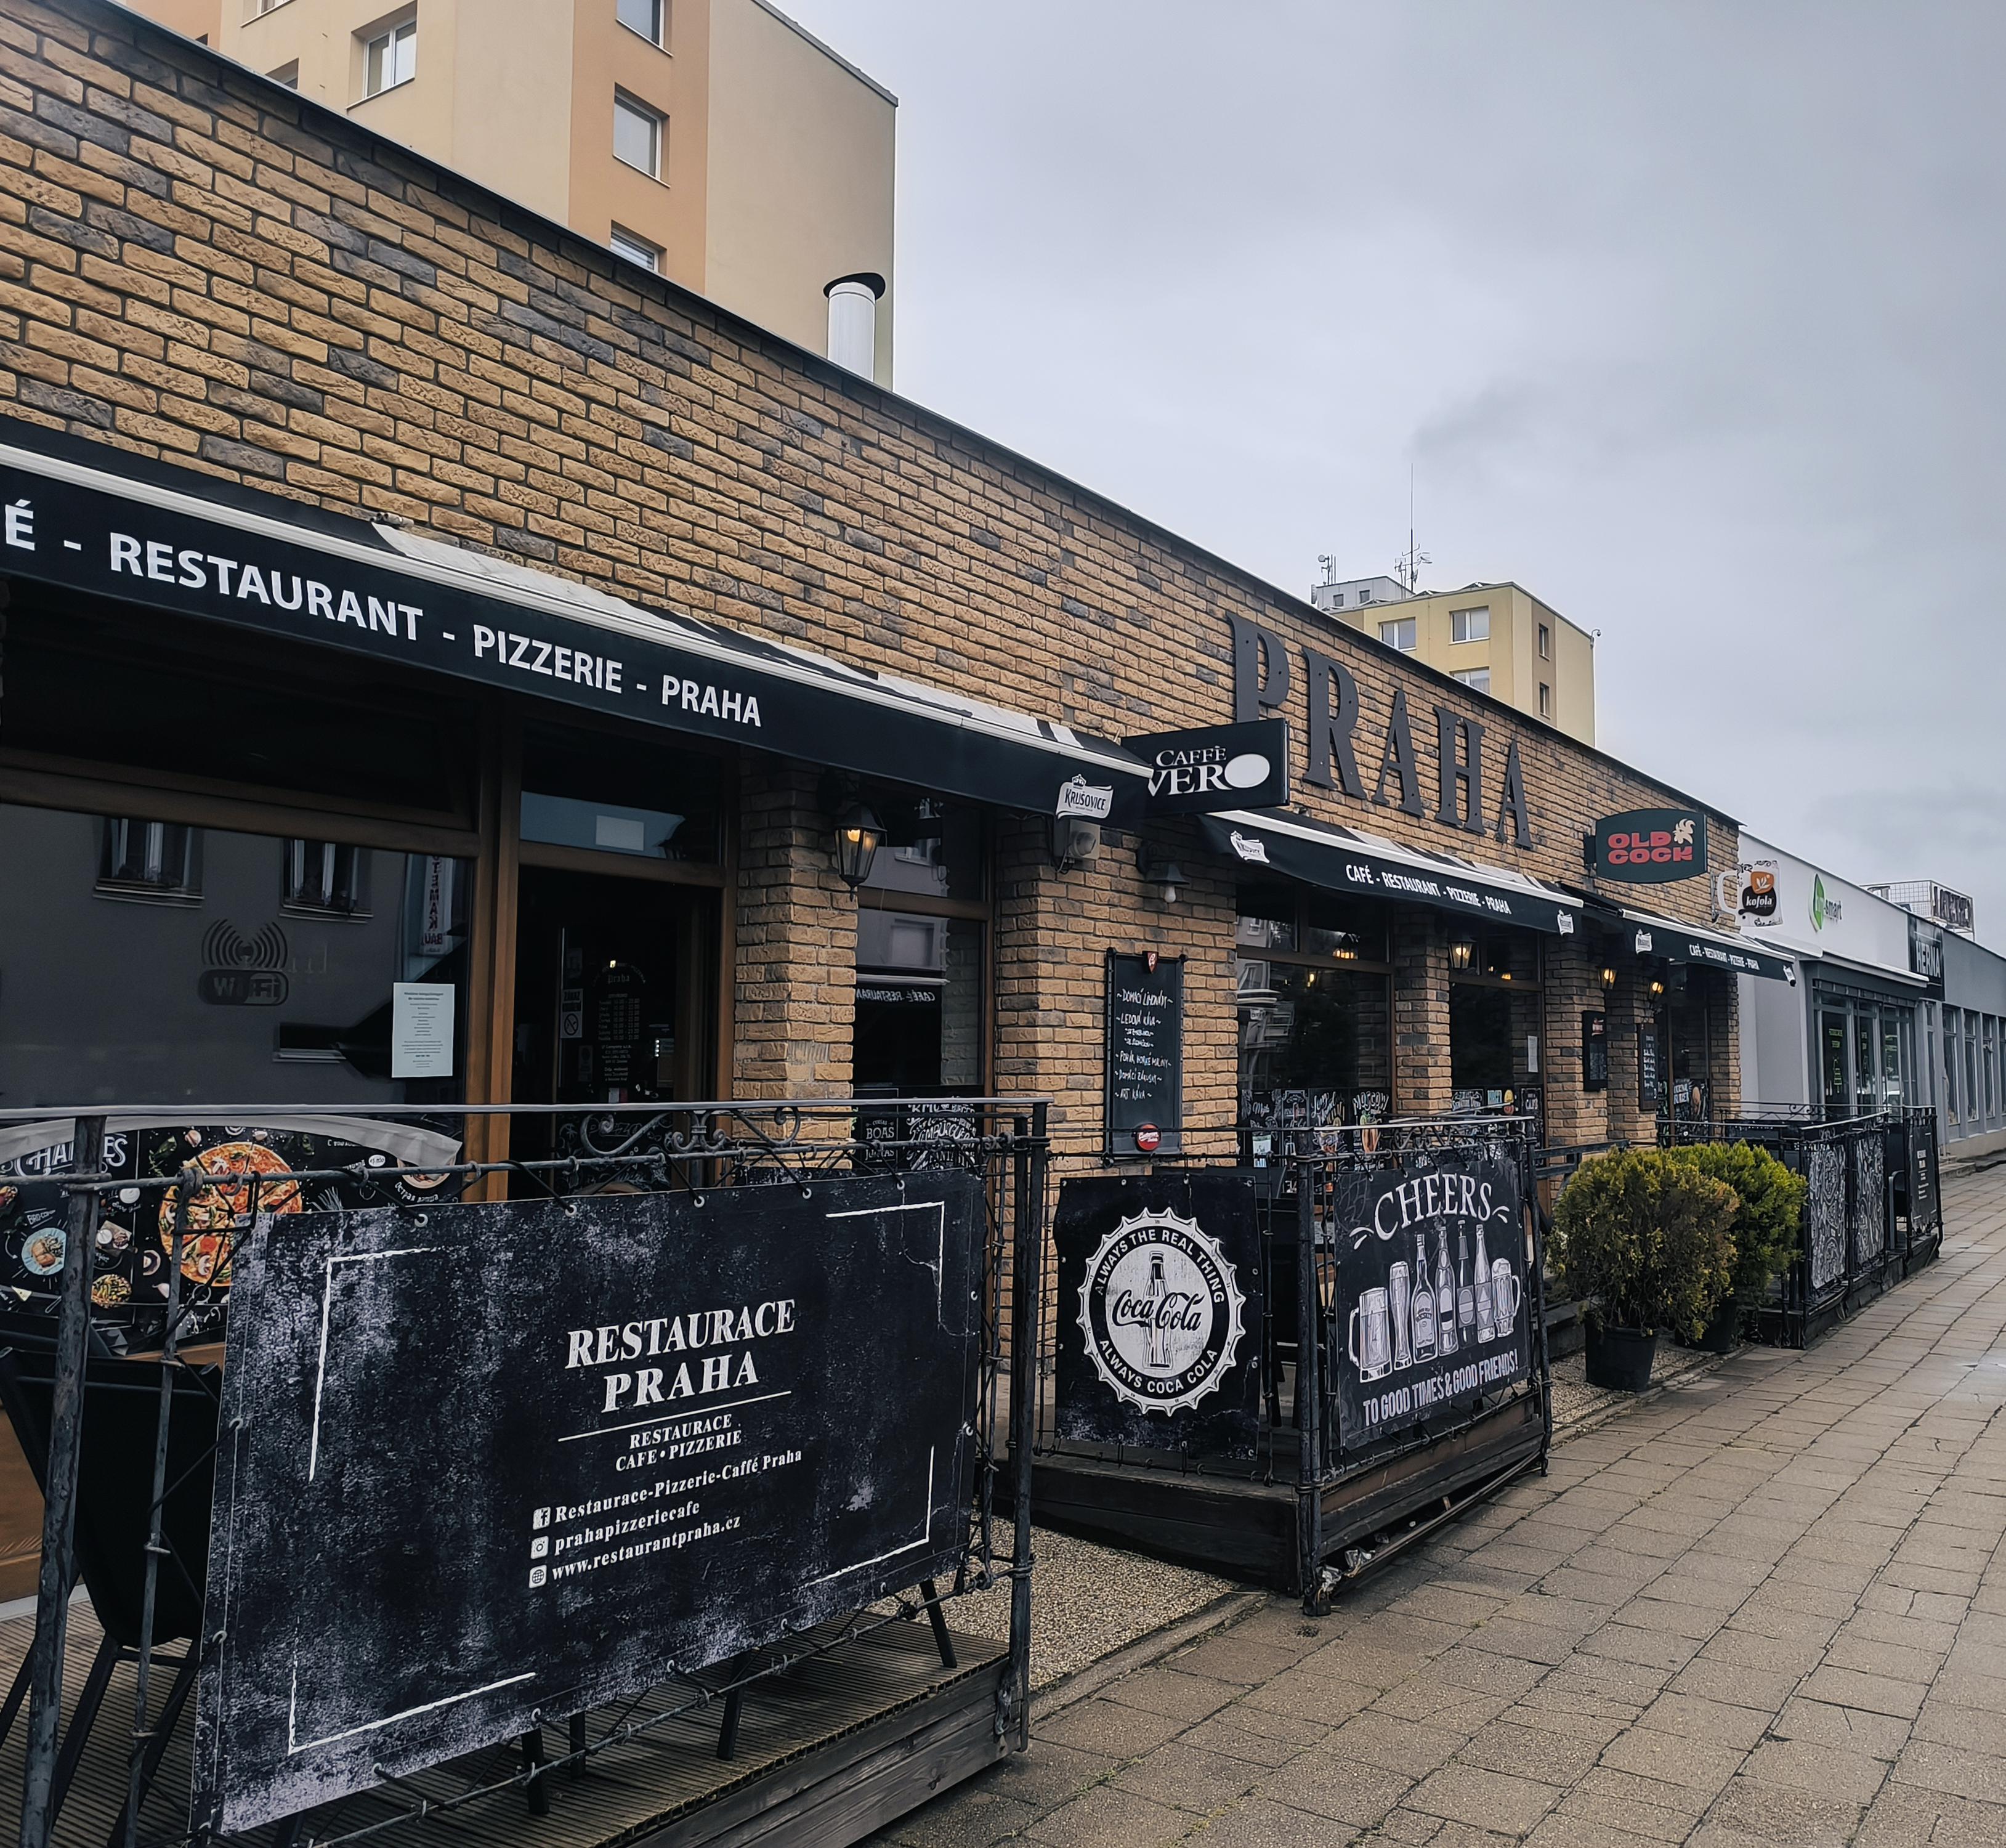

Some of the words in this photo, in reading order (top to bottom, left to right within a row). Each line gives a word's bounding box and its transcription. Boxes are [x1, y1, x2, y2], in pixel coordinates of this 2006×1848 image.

[110, 532, 423, 641] RESTAURANT
[473, 624, 623, 694] PIZZERIE
[662, 675, 761, 727] PRAHA
[1227, 613, 1533, 849] PRAHA
[1608, 830, 1672, 849] OLD
[1608, 846, 1693, 864] COCK
[1346, 864, 1374, 885] CAFÉ
[1381, 872, 1441, 898] RESTAURANT
[1485, 896, 1512, 915] PRAHA
[1746, 895, 1773, 909] kofola
[1915, 941, 1941, 978] HERNA
[866, 1127, 894, 1140] BOAS
[1374, 1173, 1493, 1241] CHEERS
[1095, 1241, 1128, 1295] ALWAYS
[1128, 1229, 1156, 1246] THE
[1161, 1230, 1194, 1256] REAL
[1197, 1251, 1225, 1303] THING
[564, 1298, 796, 1369] RESTAURACE
[601, 1350, 759, 1413] PRAHA
[1099, 1339, 1142, 1388] ALWAYS
[1147, 1379, 1184, 1394] COCA
[1186, 1349, 1218, 1383] COLA
[1364, 1398, 1378, 1427] TO
[1380, 1387, 1411, 1420] GOOD
[1412, 1376, 1444, 1410] TIMES
[1445, 1375, 1452, 1398] &
[1452, 1362, 1478, 1394] GOOD
[1478, 1348, 1518, 1385] FRIENDS!
[629, 1413, 732, 1449] RESTAURACE
[554, 1460, 759, 1523] Restaurace-Pizzerie-Caffé
[761, 1449, 803, 1471] Praha
[552, 1515, 742, 1581] www.restaurantpraha.cz
[554, 1501, 700, 1556] prahapizzeriecafe
